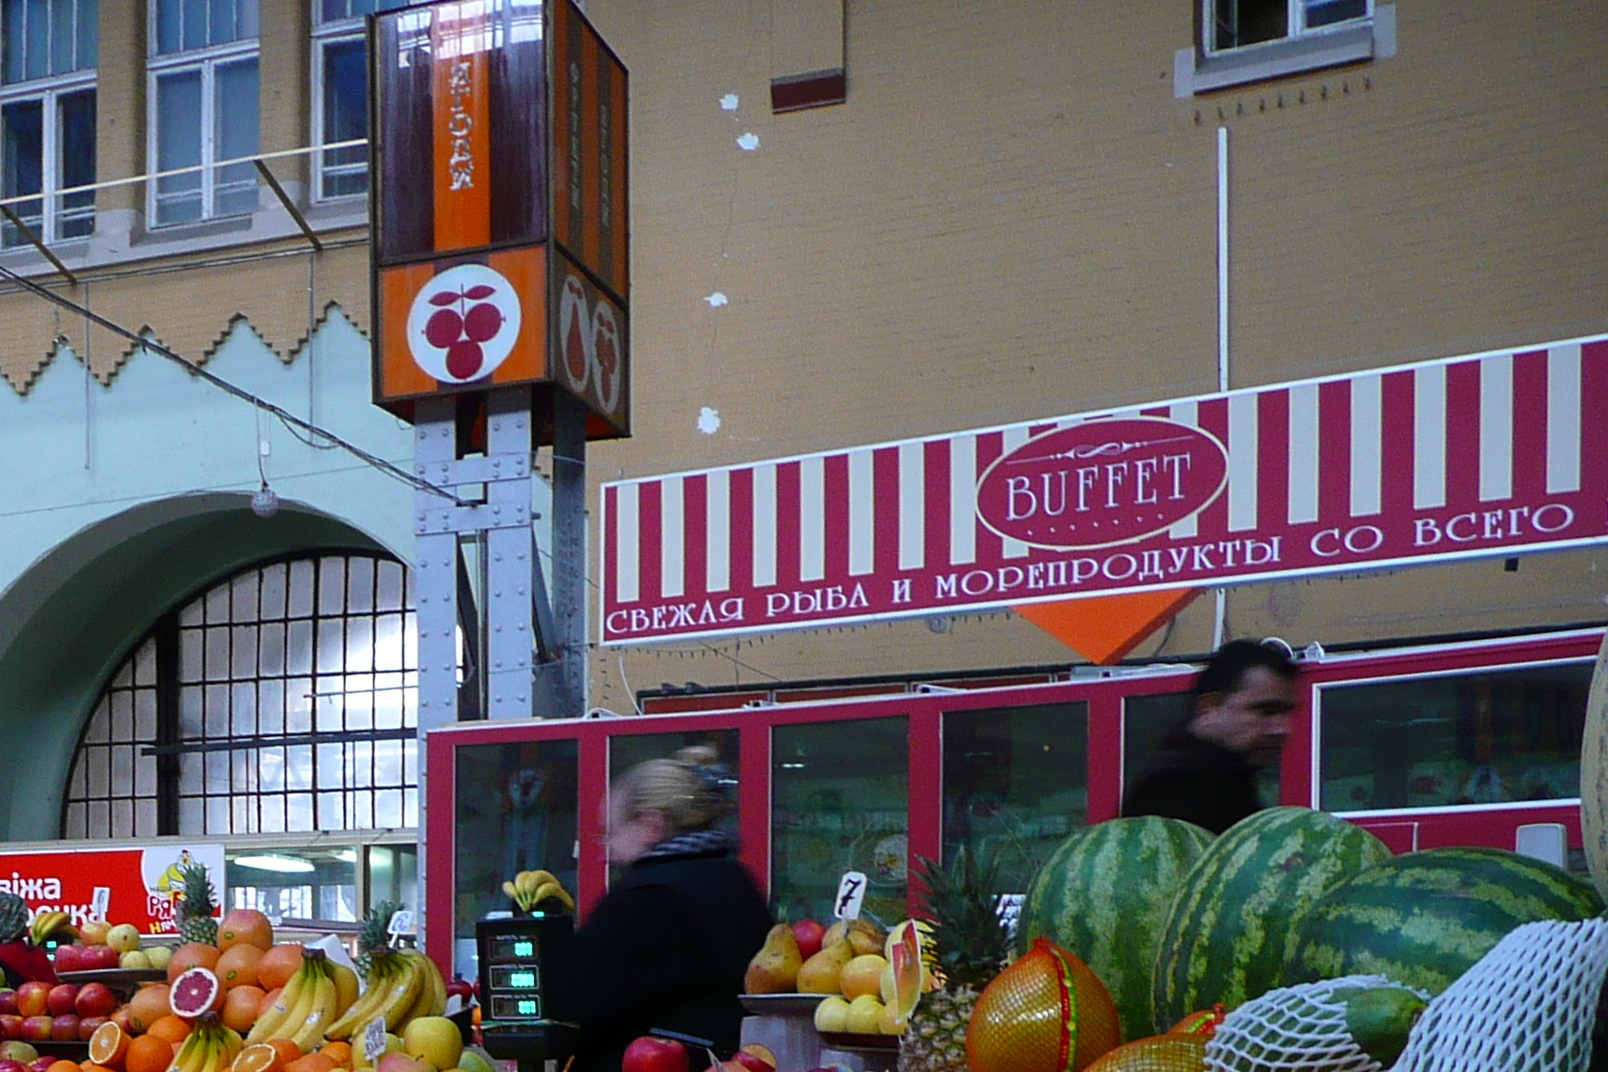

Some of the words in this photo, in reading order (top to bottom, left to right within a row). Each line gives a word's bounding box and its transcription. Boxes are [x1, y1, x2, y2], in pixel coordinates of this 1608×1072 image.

[448, 62, 475, 191] ЯГОДИ
[1005, 450, 1191, 521] BUFFET
[605, 597, 746, 635] СВЕЖАЯ
[765, 581, 869, 617] РЫБА
[891, 577, 912, 604] И
[934, 535, 1282, 600] МОРЕПРОДУКТЫ
[1310, 525, 1383, 558] СО
[1413, 502, 1575, 548] ВСЕГО
[836, 878, 862, 916] 7
